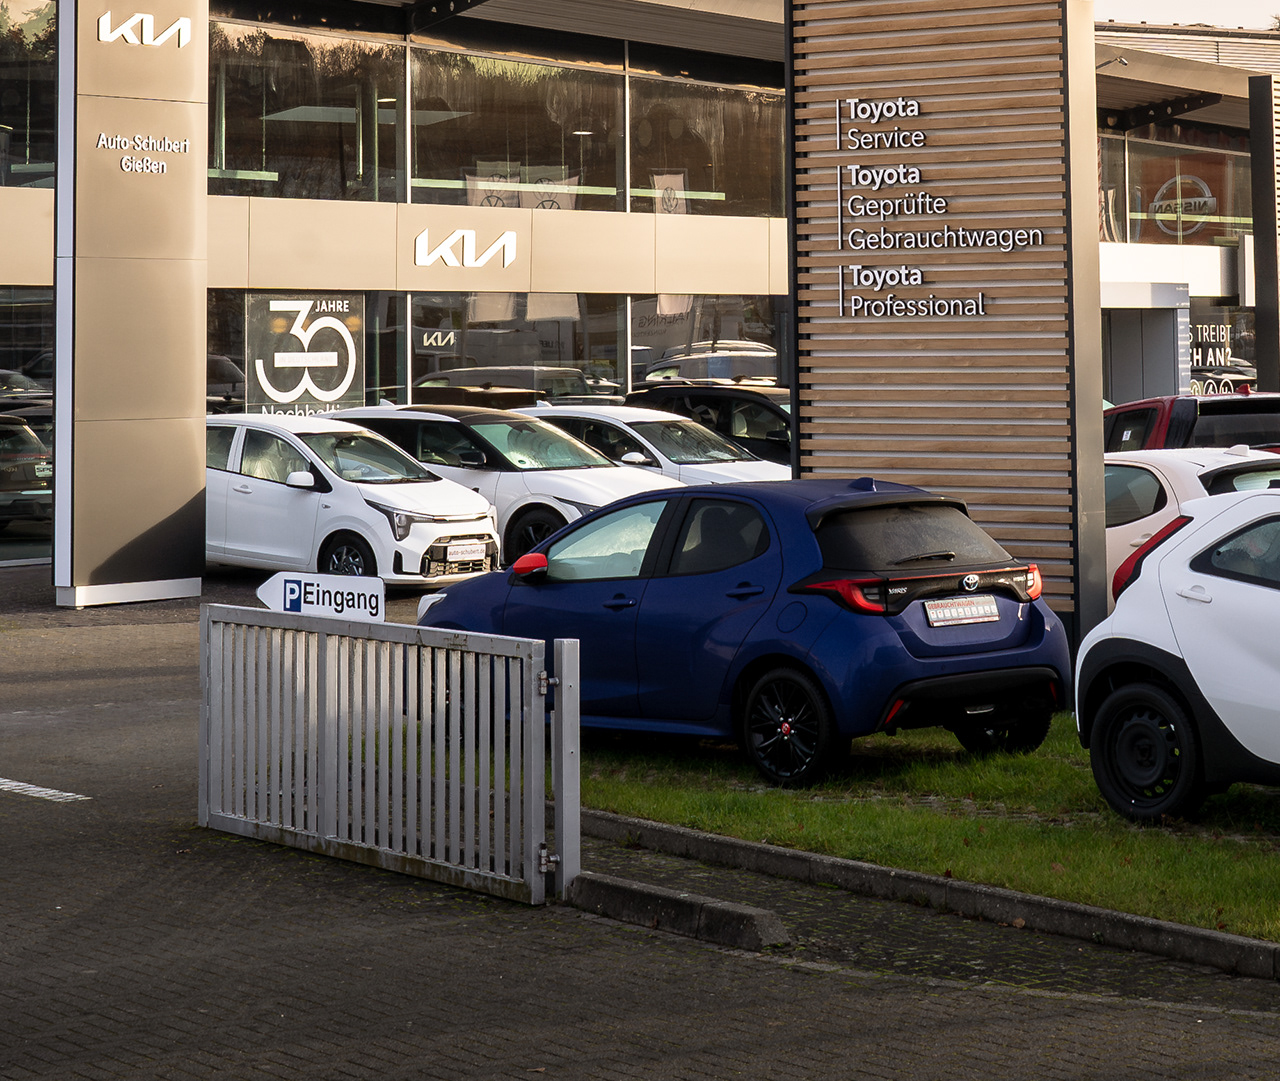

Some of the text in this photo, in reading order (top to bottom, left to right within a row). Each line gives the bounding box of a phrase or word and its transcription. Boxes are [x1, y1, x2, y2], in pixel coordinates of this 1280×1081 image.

[846, 96, 920, 124] Toyota
[96, 132, 191, 154] Auto-Schubert
[847, 126, 925, 150] Service
[120, 156, 167, 174] Gießen
[847, 164, 921, 191] Toyota
[847, 192, 947, 221] Geprüfte
[847, 225, 1043, 252] Gebrauchtwagen
[849, 264, 923, 292] Toyota
[315, 300, 350, 313] JAHRE
[851, 292, 985, 317] Professional
[1196, 324, 1232, 343] TREIBT
[1206, 346, 1232, 366] AN?
[302, 582, 379, 617] Eingang
